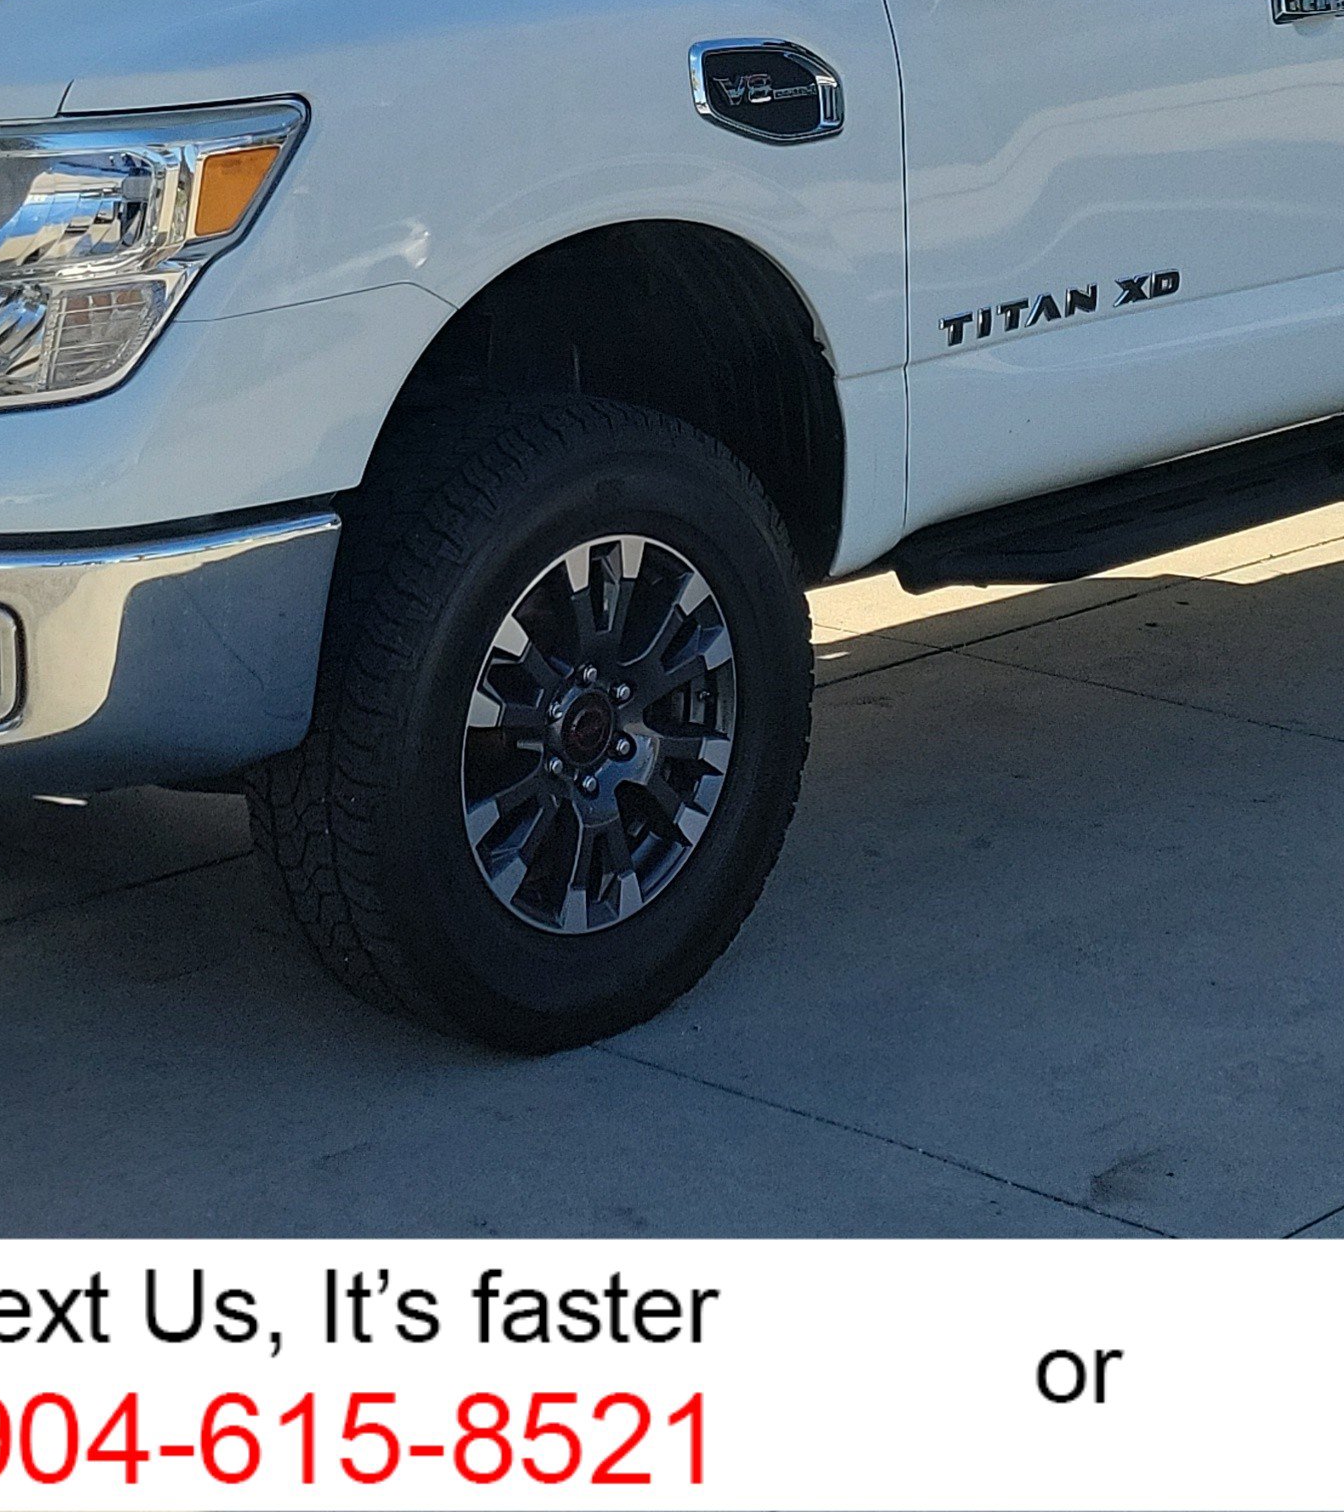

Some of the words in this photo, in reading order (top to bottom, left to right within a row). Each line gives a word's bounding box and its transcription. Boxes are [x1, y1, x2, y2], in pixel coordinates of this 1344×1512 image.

[712, 73, 773, 106] V8
[938, 282, 1099, 347] TITAN
[1112, 267, 1182, 308] XD
